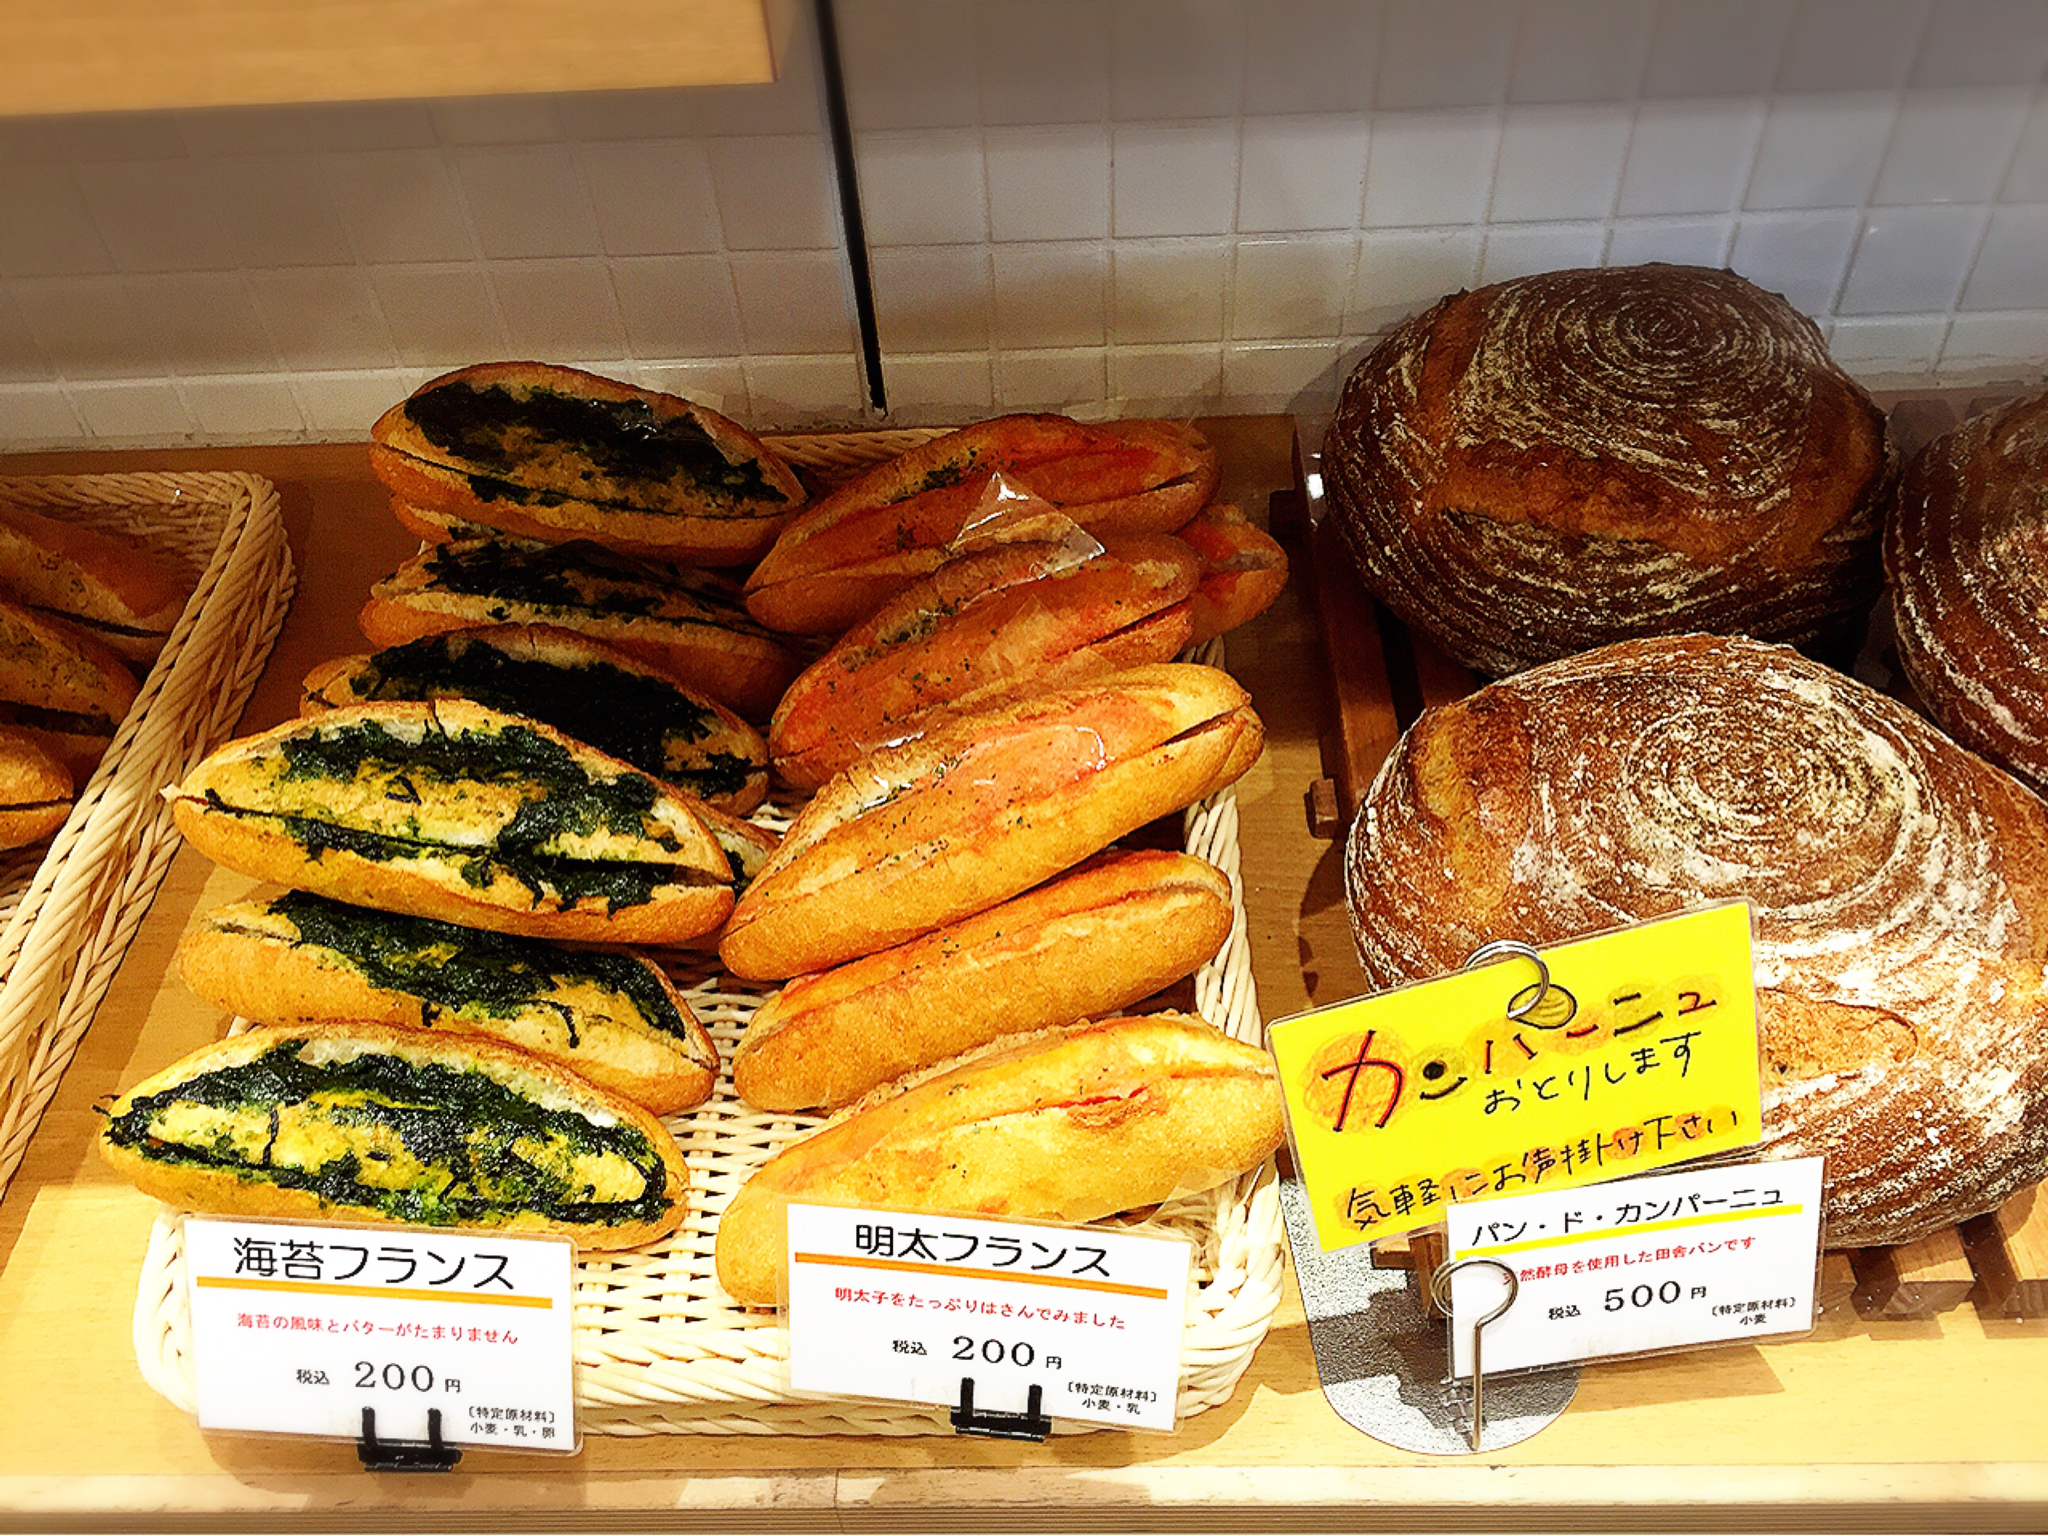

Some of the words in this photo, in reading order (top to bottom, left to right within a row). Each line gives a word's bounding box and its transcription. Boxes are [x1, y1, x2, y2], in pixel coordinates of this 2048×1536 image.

[1484, 1031, 1702, 1116] おとりします
[1346, 1110, 1742, 1231] 気軽にお声掛け下さい
[1471, 1188, 1784, 1247] パン・ド・カンパーニュ
[233, 1237, 515, 1290] 海苔フランス
[855, 1223, 1111, 1277] 明太フランス
[236, 1312, 519, 1345] 海苔の風味とバターがたまりません
[834, 1286, 1126, 1330] 明太子をたっぷりはさんでみました
[1548, 1304, 1582, 1321] 税込
[1739, 1313, 1768, 1326] 小麦
[892, 1340, 928, 1356] 税込
[296, 1368, 330, 1386] 税込
